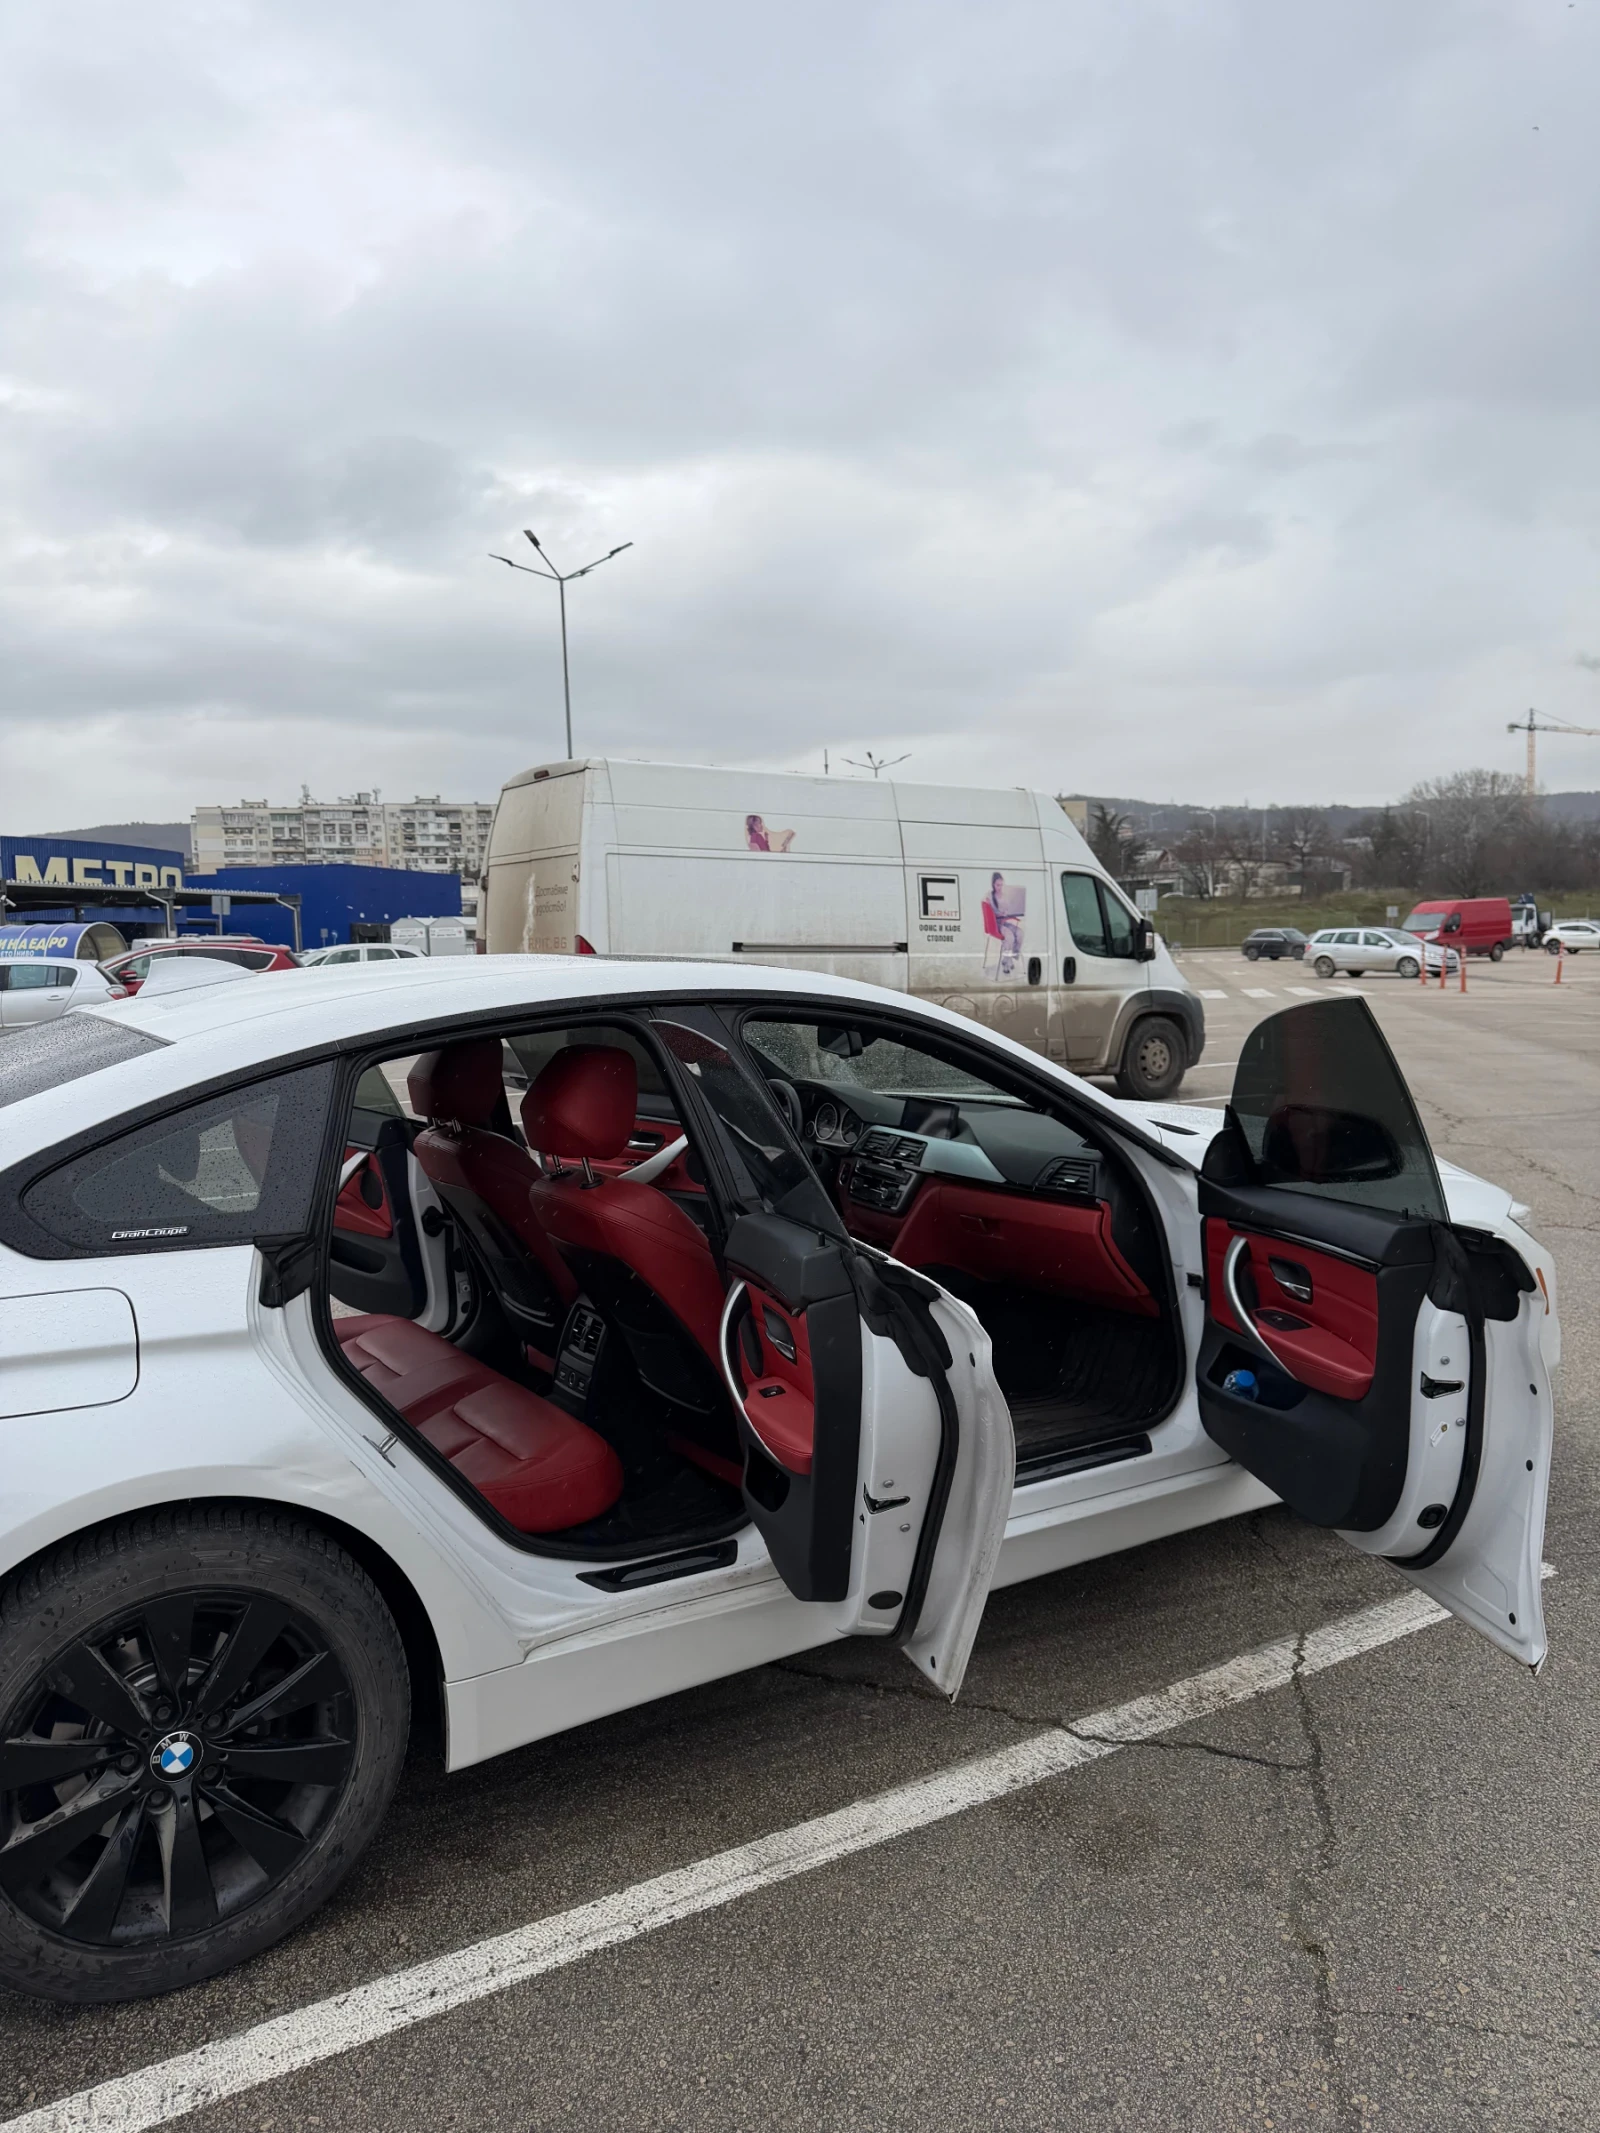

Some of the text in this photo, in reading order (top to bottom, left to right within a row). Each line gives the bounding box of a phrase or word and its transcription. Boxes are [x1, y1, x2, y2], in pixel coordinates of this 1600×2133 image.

[919, 924, 937, 932] ОФИС
[29, 937, 68, 950] ЕДРО
[152, 1733, 189, 1764] BMW
